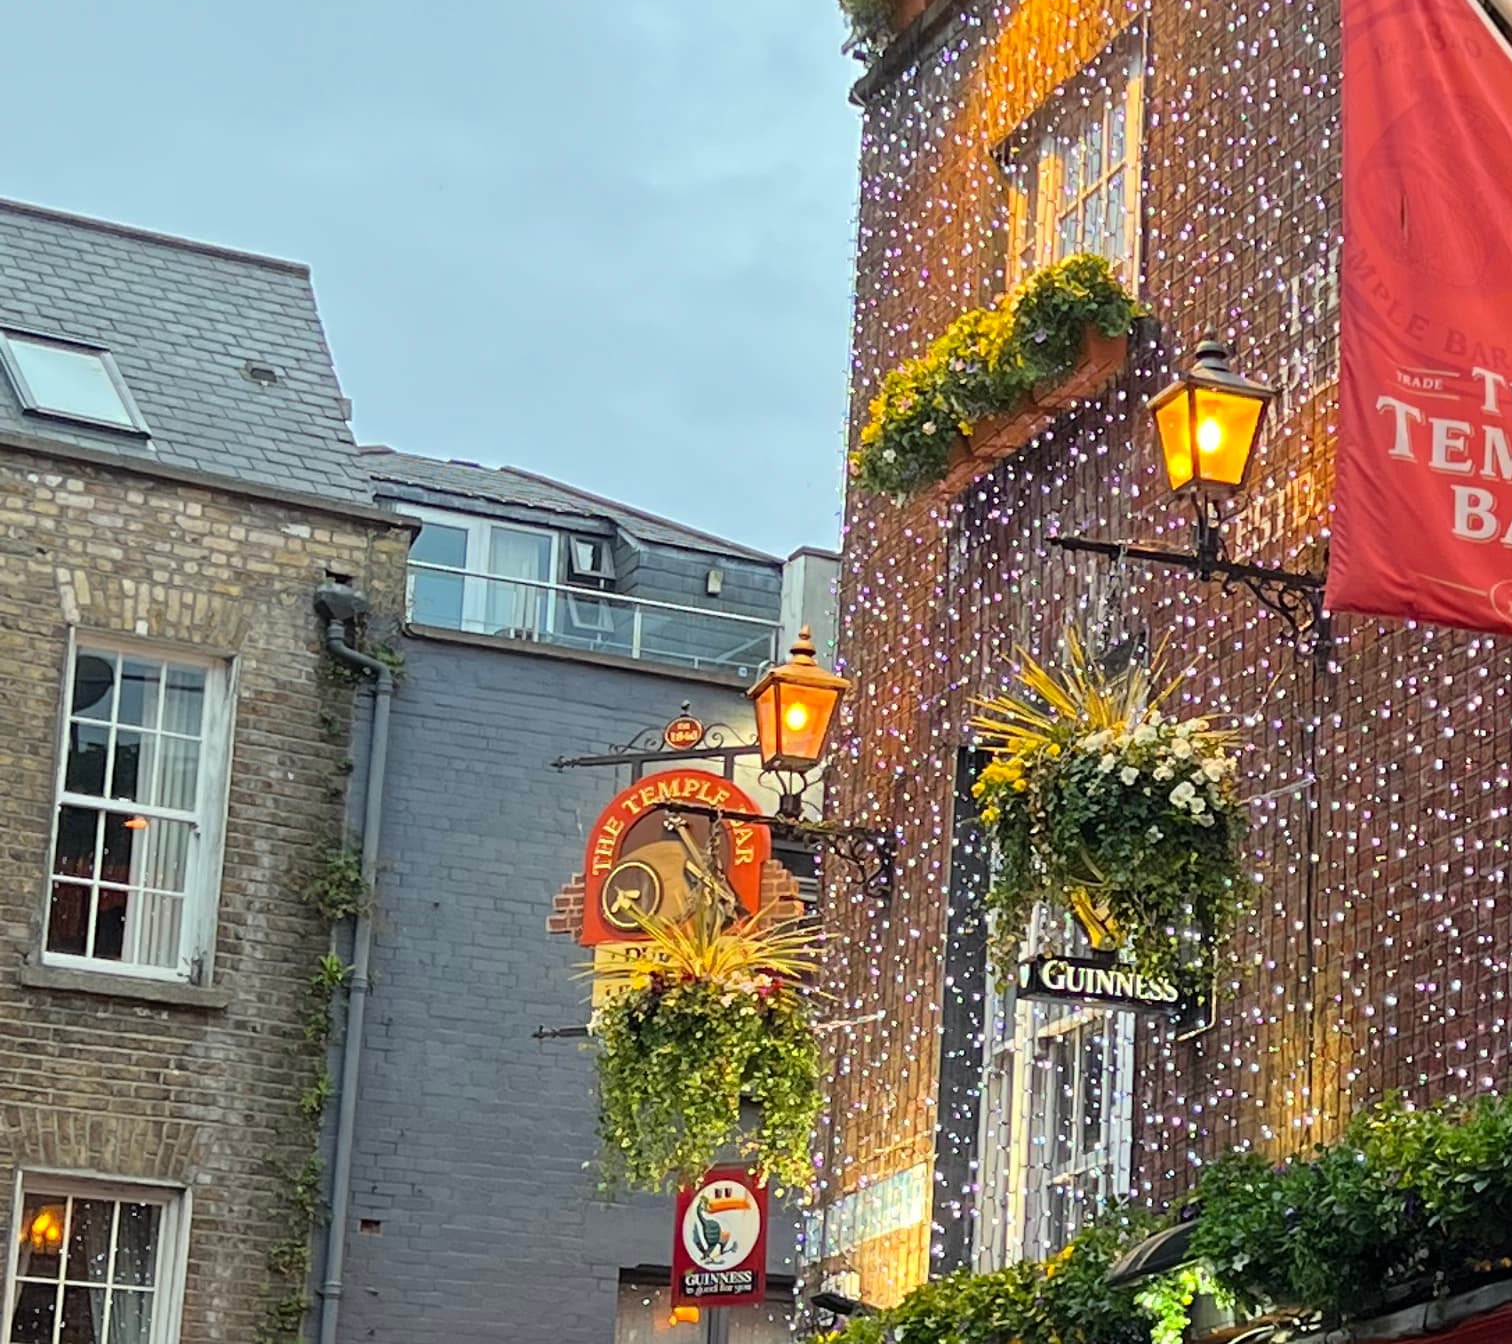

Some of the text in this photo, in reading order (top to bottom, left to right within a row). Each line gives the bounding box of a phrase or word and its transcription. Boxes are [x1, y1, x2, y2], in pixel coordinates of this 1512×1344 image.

[1396, 370, 1444, 391] TRADE
[592, 816, 624, 876] THE
[621, 776, 731, 816] TEMPLE
[685, 1270, 753, 1287] GUINNESS
